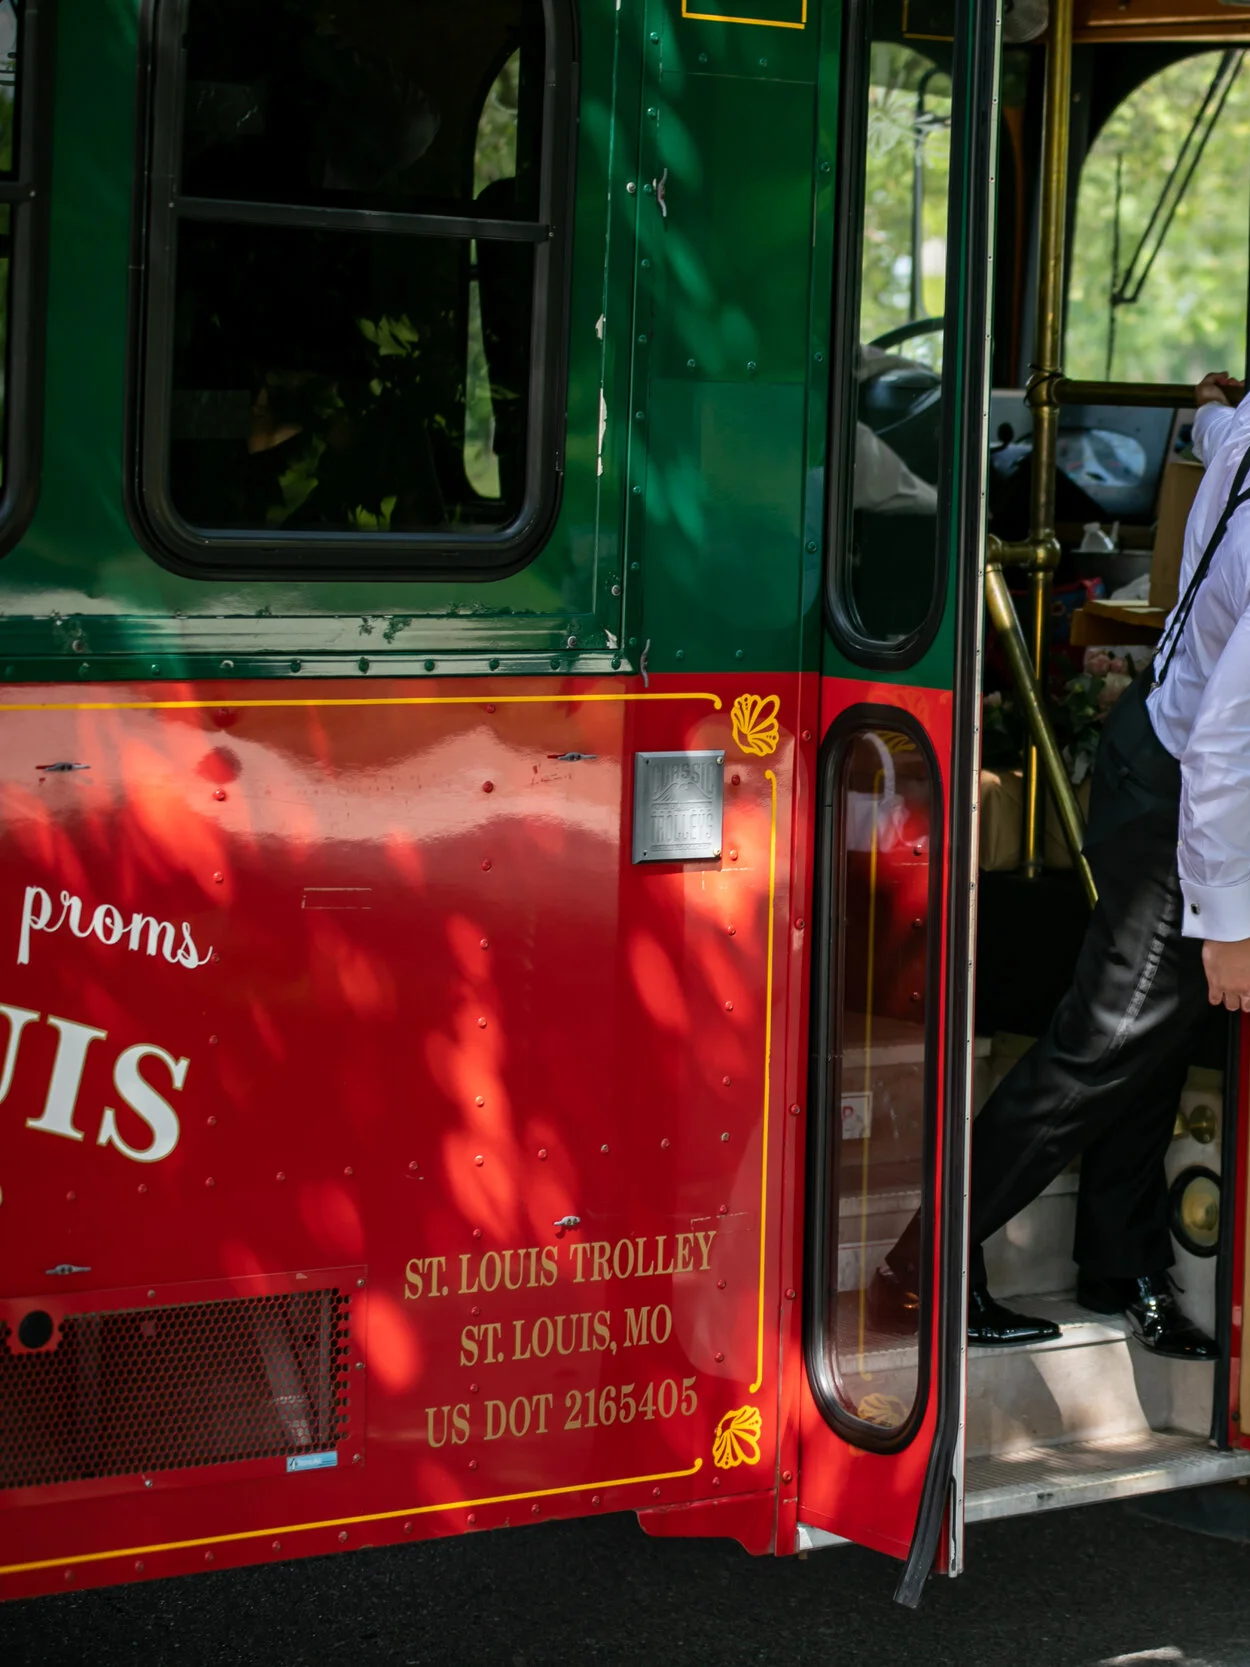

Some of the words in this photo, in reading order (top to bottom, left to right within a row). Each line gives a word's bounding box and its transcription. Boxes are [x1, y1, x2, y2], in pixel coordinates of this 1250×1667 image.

[17, 886, 212, 968] proms
[404, 1257, 448, 1299] ST.
[458, 1246, 558, 1294] LOUIS
[569, 1231, 716, 1283] TROLLEY
[460, 1323, 503, 1366] ST.
[512, 1310, 616, 1360] LOUIS,
[624, 1304, 672, 1347] MO
[425, 1404, 470, 1448] US
[483, 1394, 553, 1440] DOT
[564, 1376, 698, 1430] 2165405
